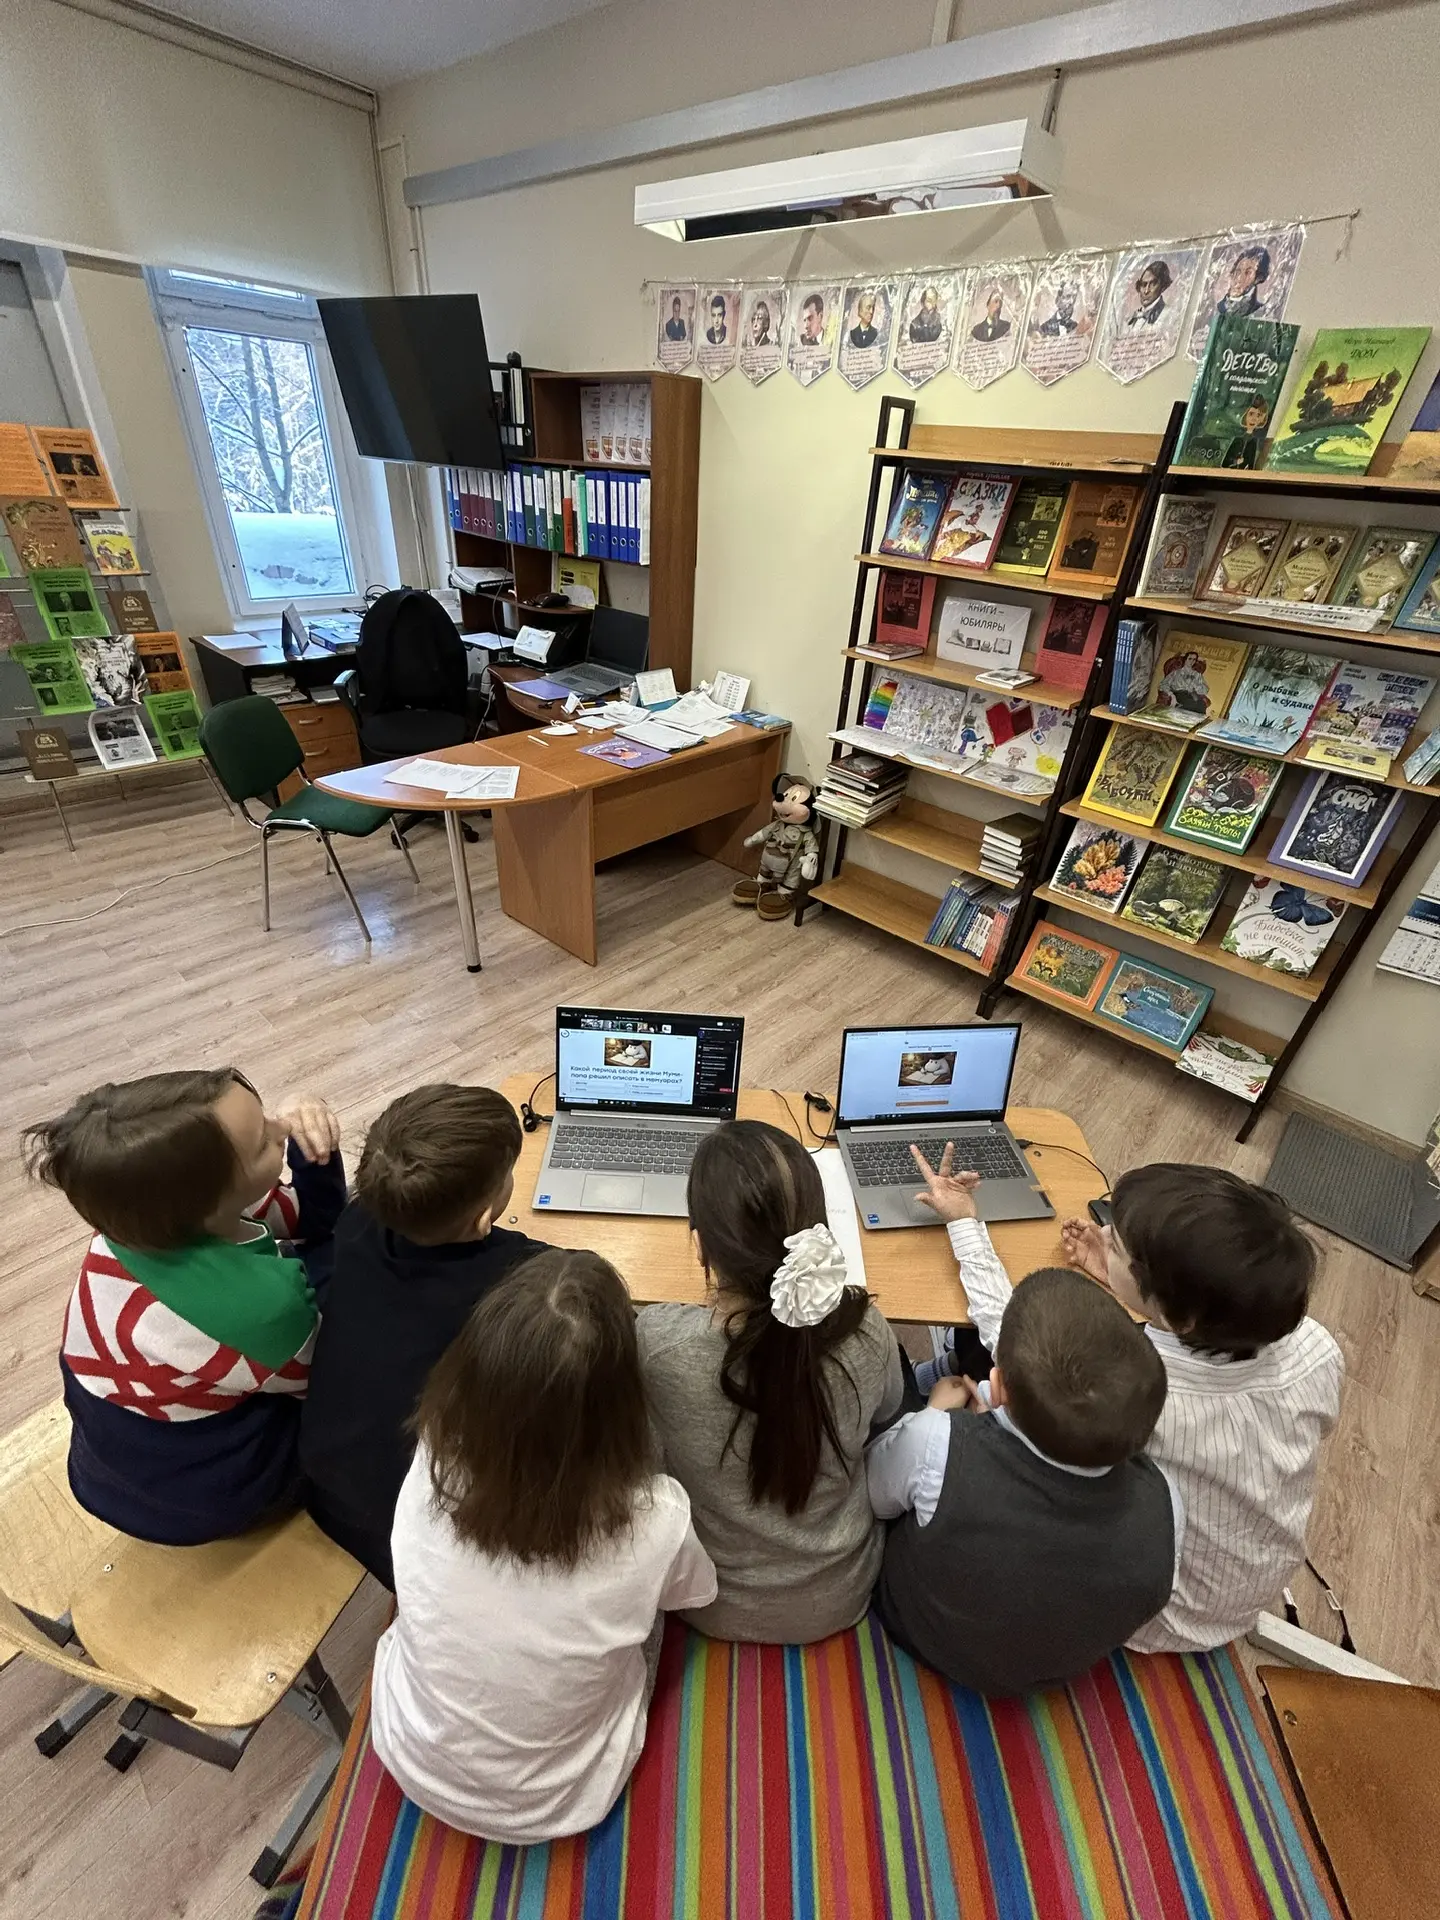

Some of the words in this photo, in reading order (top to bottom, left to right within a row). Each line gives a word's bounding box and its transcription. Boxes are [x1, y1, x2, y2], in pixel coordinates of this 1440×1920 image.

[960, 480, 1008, 502] СКАЗКИ
[968, 603, 997, 615] КНИГИ
[960, 616, 1006, 632] ЮБИЛЯРЫ
[1252, 682, 1260, 690] О
[1261, 685, 1299, 696] рыбаке
[1280, 698, 1315, 710] судаке
[1254, 918, 1306, 945] Бабочка
[1243, 931, 1260, 941] не
[1263, 931, 1306, 957] спешит
[592, 1067, 617, 1075] период
[588, 1073, 612, 1081] решил
[645, 1077, 683, 1085] мемуарах?
